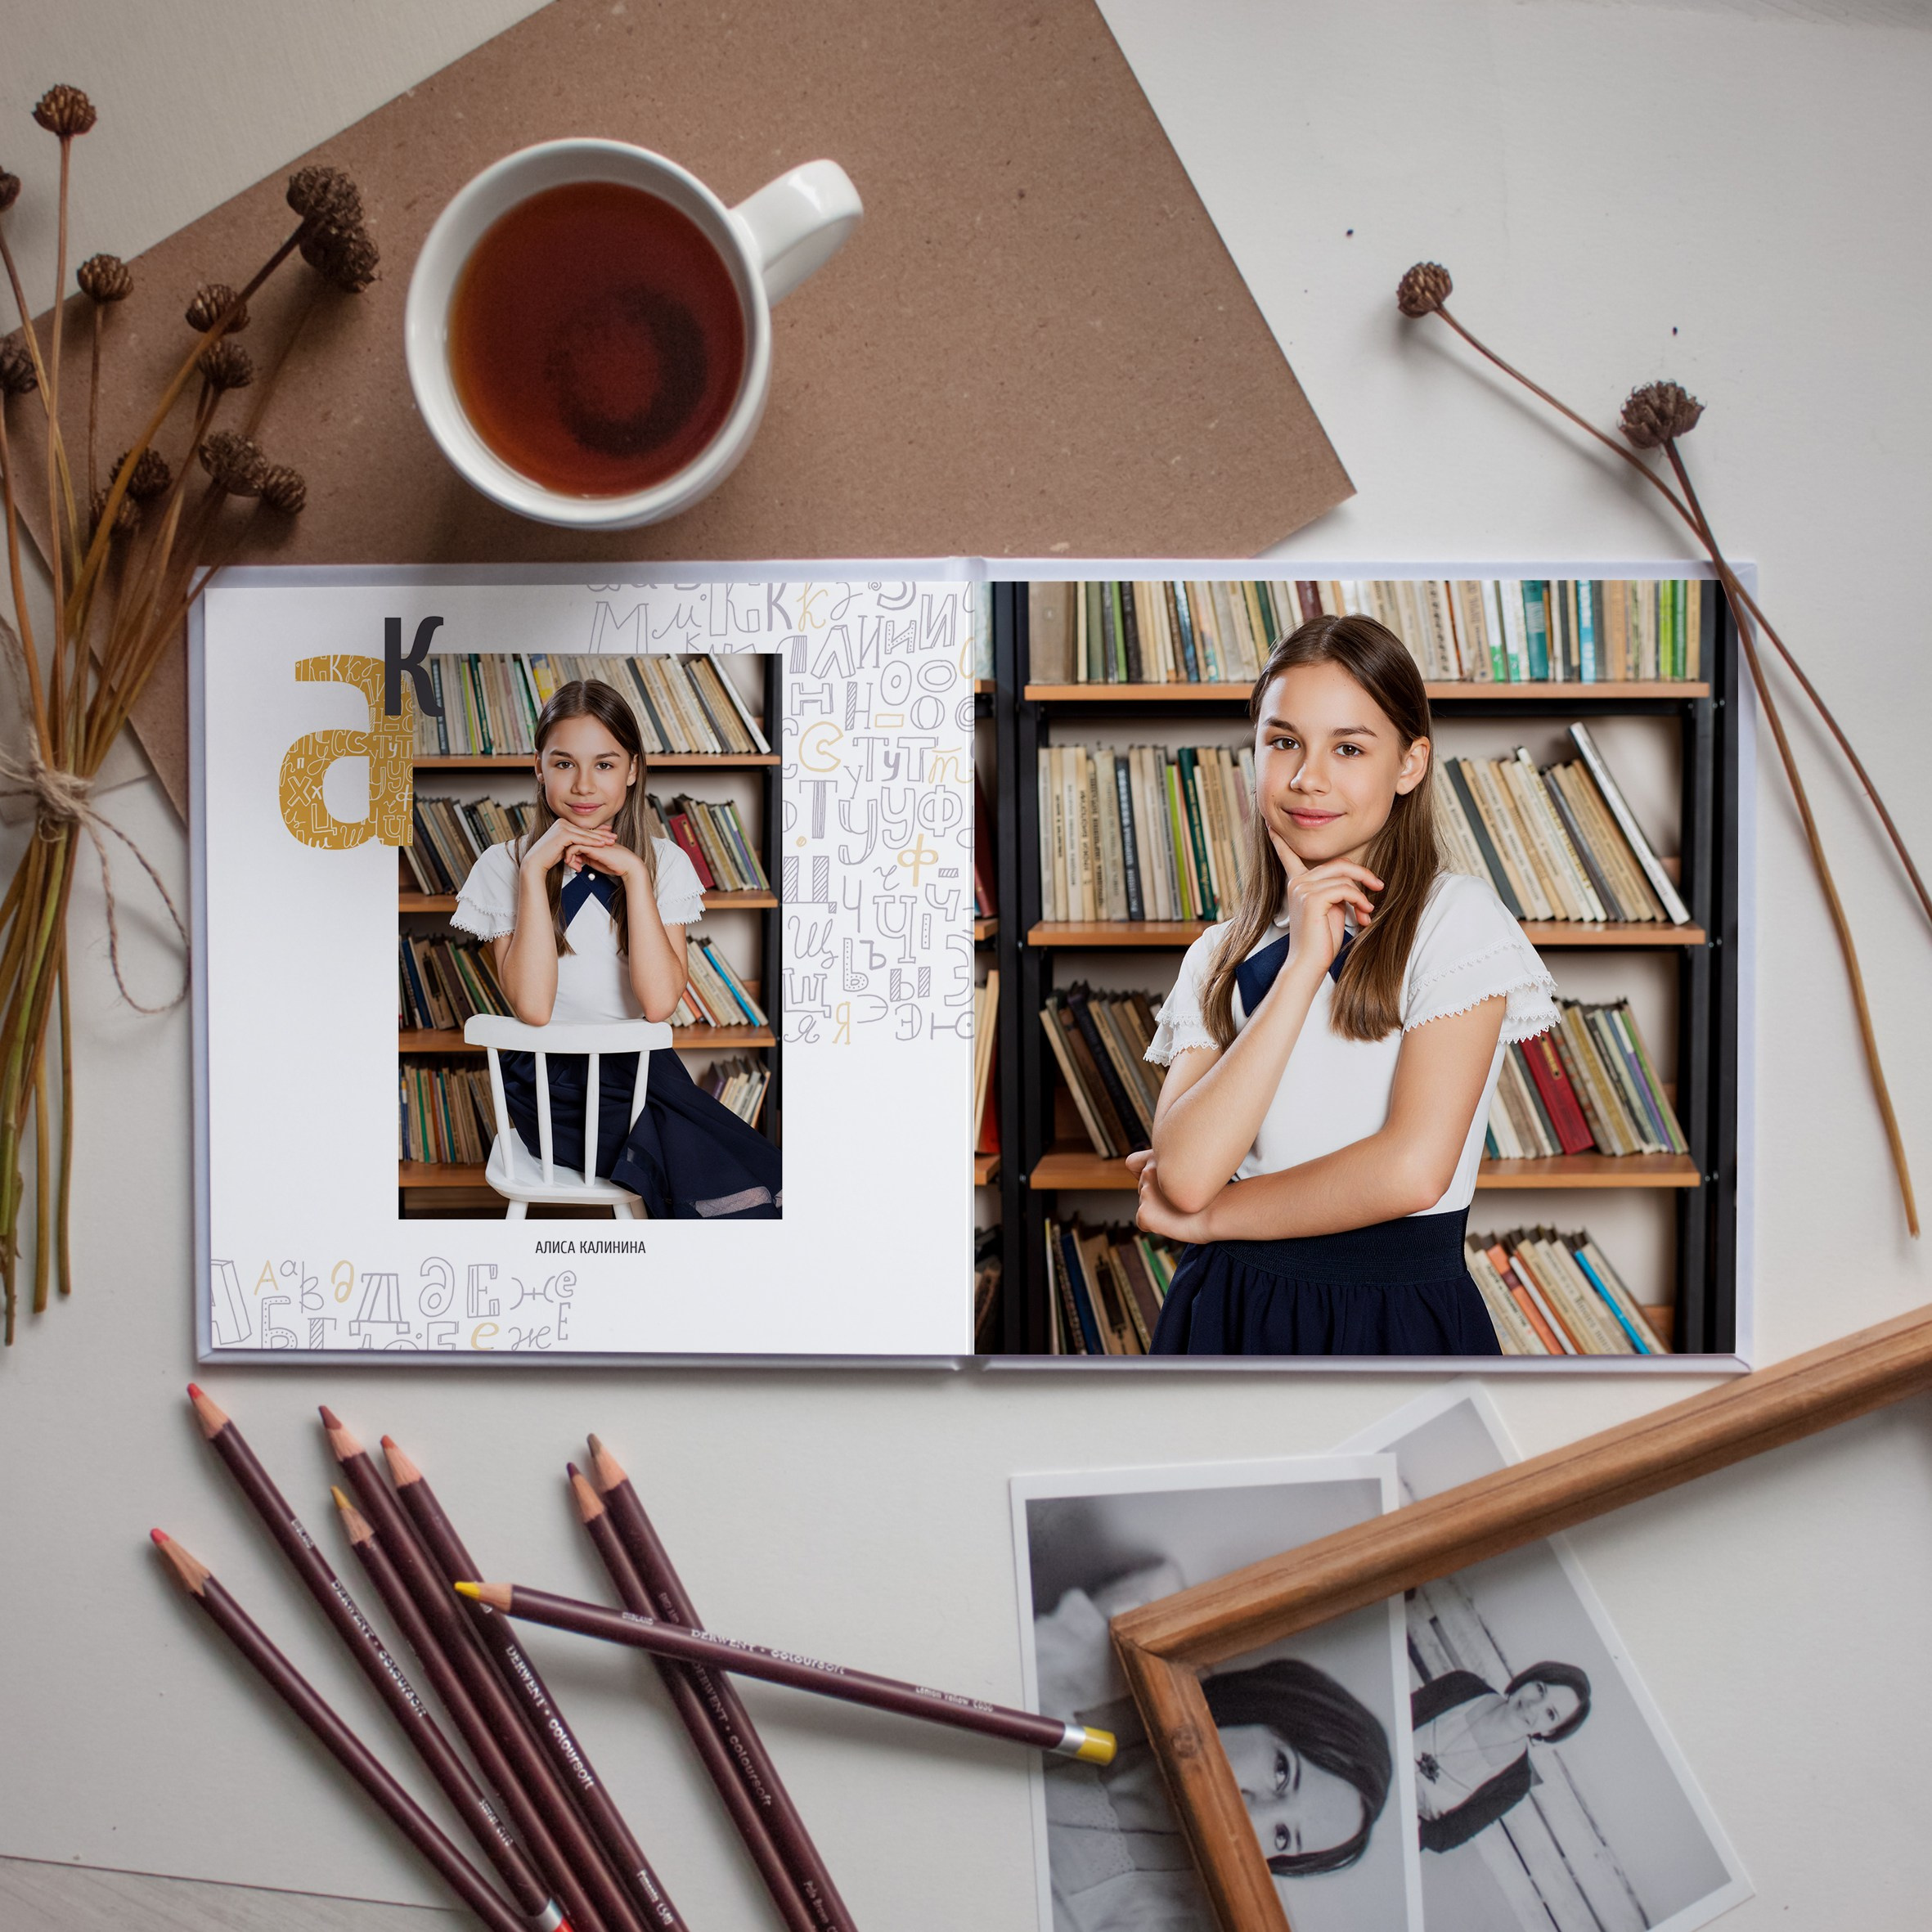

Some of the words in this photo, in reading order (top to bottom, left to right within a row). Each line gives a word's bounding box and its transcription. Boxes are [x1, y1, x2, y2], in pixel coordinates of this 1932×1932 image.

[535, 1240, 576, 1254] АЛИСА
[580, 1240, 646, 1254] КАЛИНИНА
[329, 1579, 376, 1640] DERWENT
[690, 1629, 756, 1652] DERWENT
[770, 1648, 846, 1675] coloursoft
[505, 1645, 548, 1709] DERWENT
[547, 1718, 595, 1790] coloursoft
[690, 1660, 729, 1724] DERWENT
[728, 1733, 772, 1807] coloursoft
